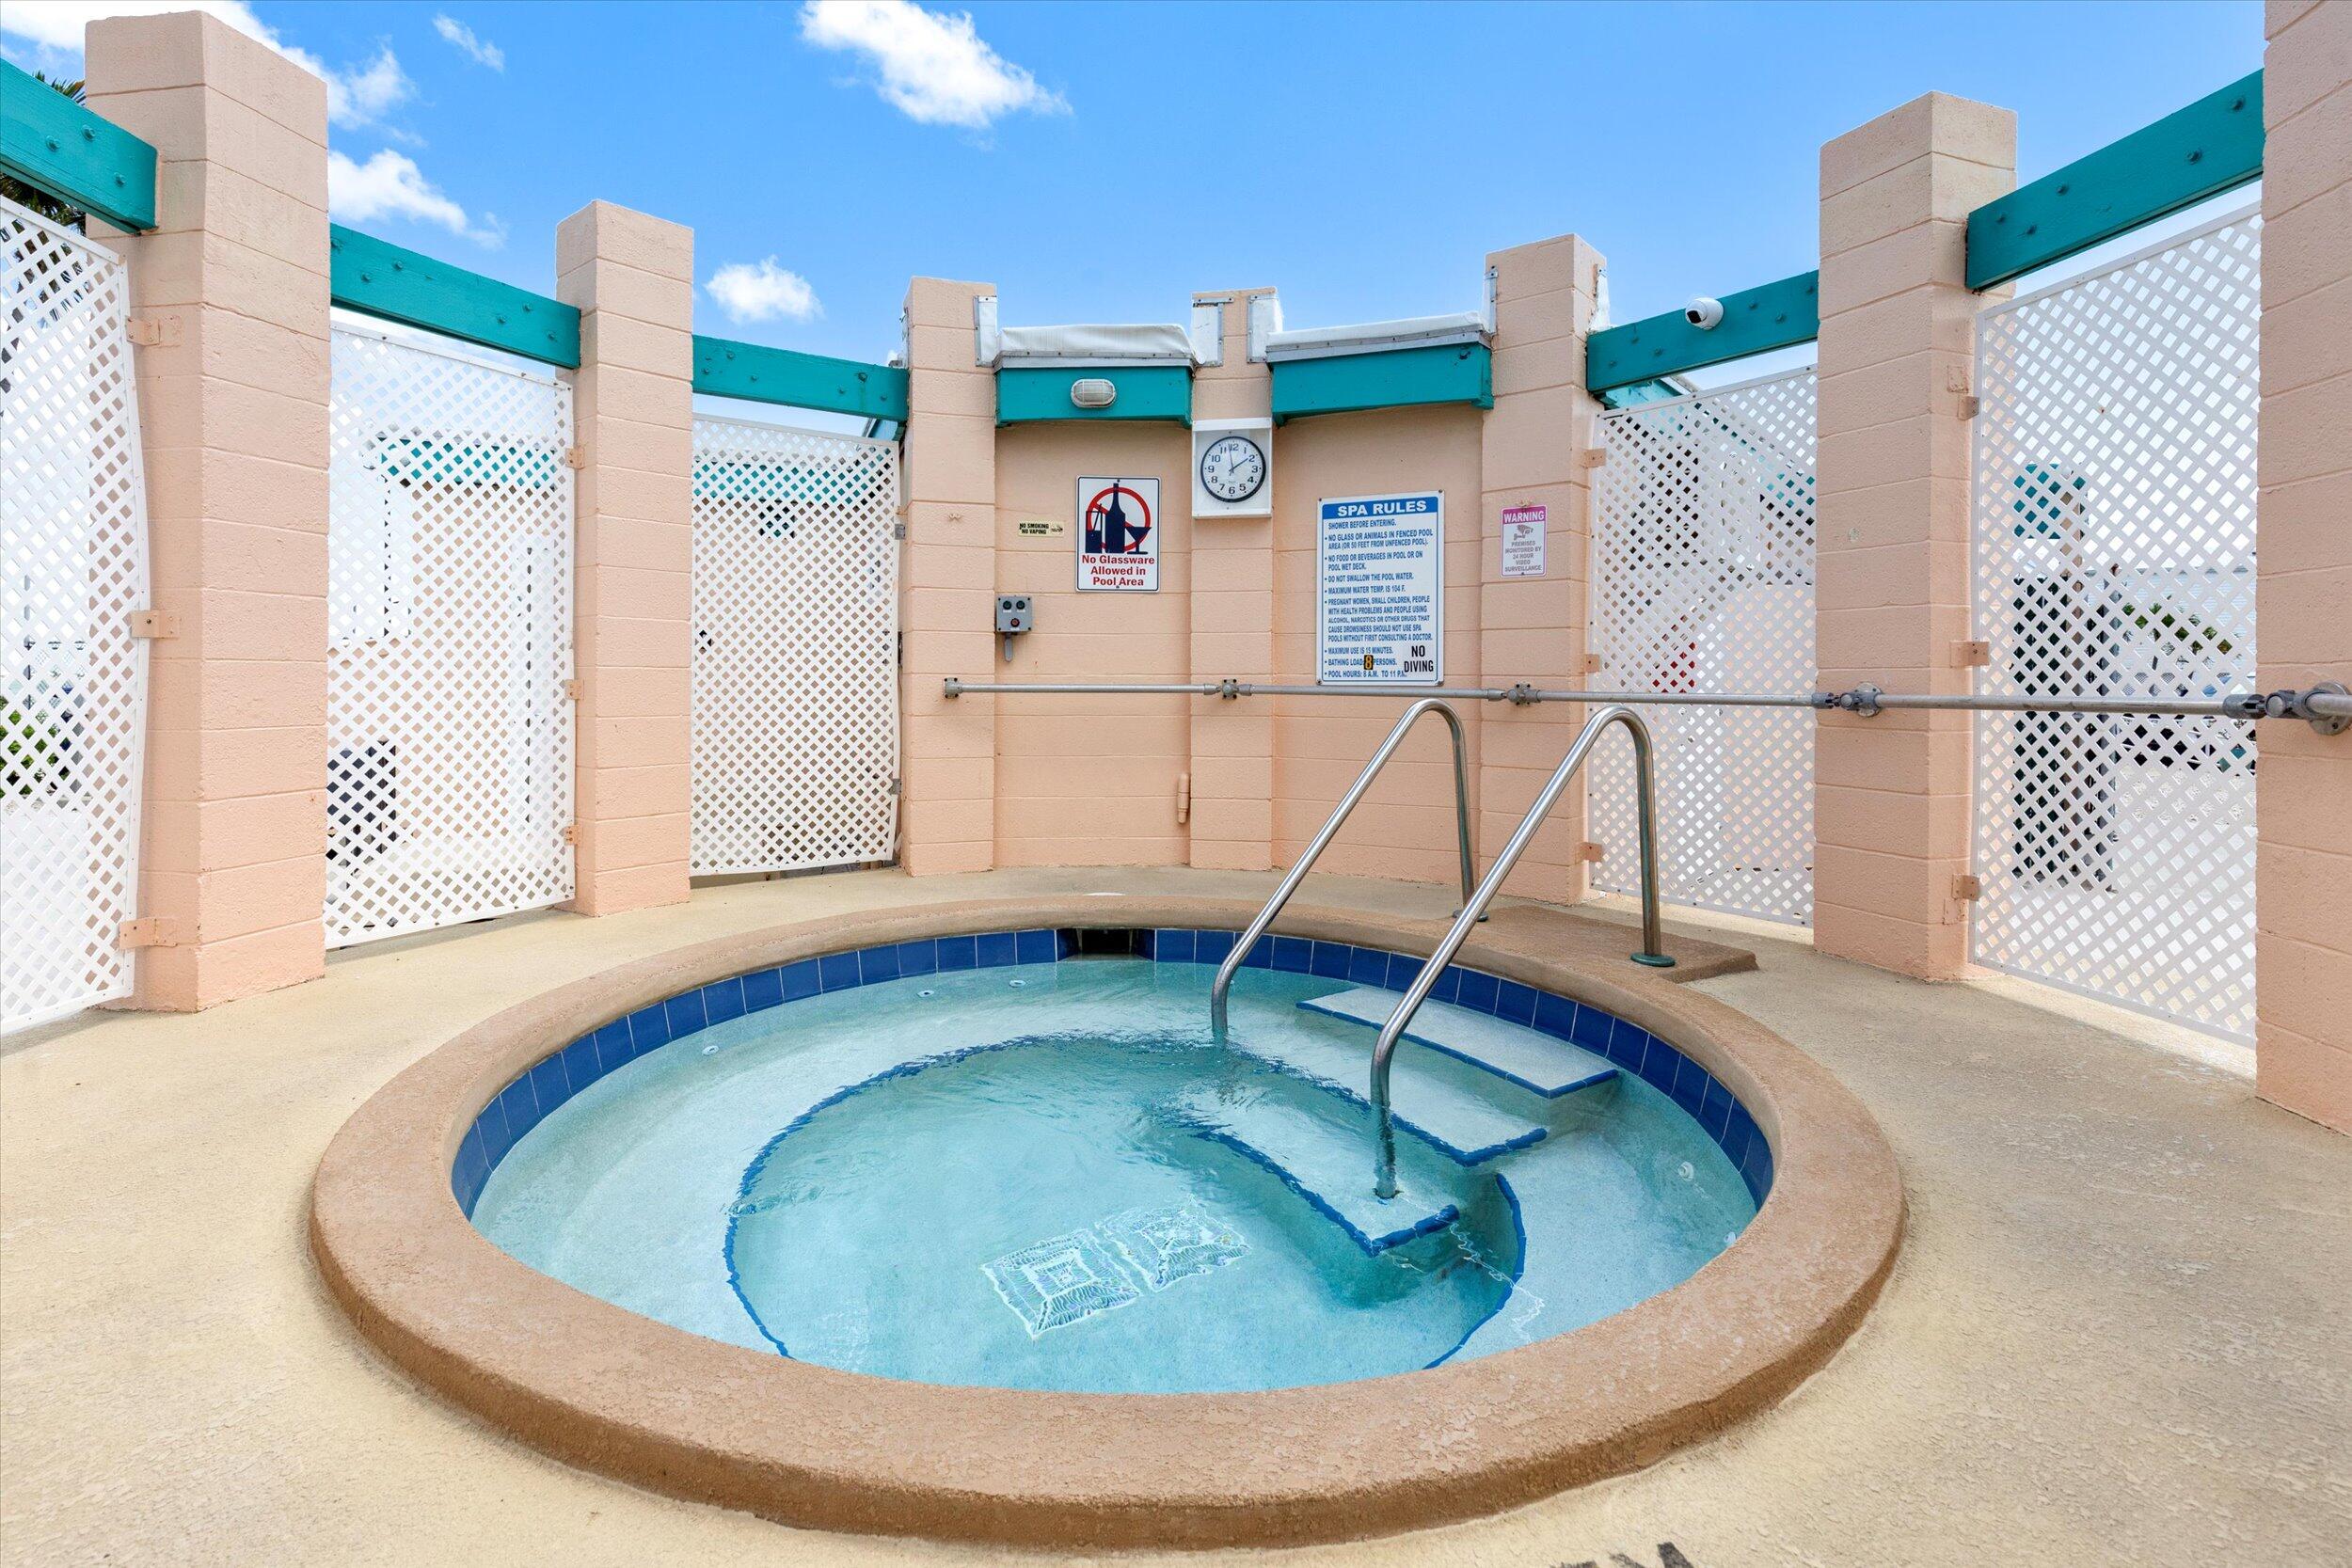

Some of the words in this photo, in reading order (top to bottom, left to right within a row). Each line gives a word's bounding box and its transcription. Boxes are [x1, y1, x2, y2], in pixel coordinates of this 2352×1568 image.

[1338, 505, 1368, 516] SPA
[1374, 500, 1426, 514] RULES
[1504, 511, 1544, 523] WARNING
[1082, 555, 1096, 563] No
[1100, 555, 1154, 564] Glassware
[1359, 552, 1386, 561] BEVERAGES
[1090, 566, 1133, 575] Allowed
[1136, 566, 1146, 575] in
[1093, 577, 1116, 585] Pool
[1119, 578, 1144, 586] Area
[1411, 645, 1425, 657] NO
[1364, 655, 1373, 670] 8
[1405, 660, 1434, 673] DIVING
